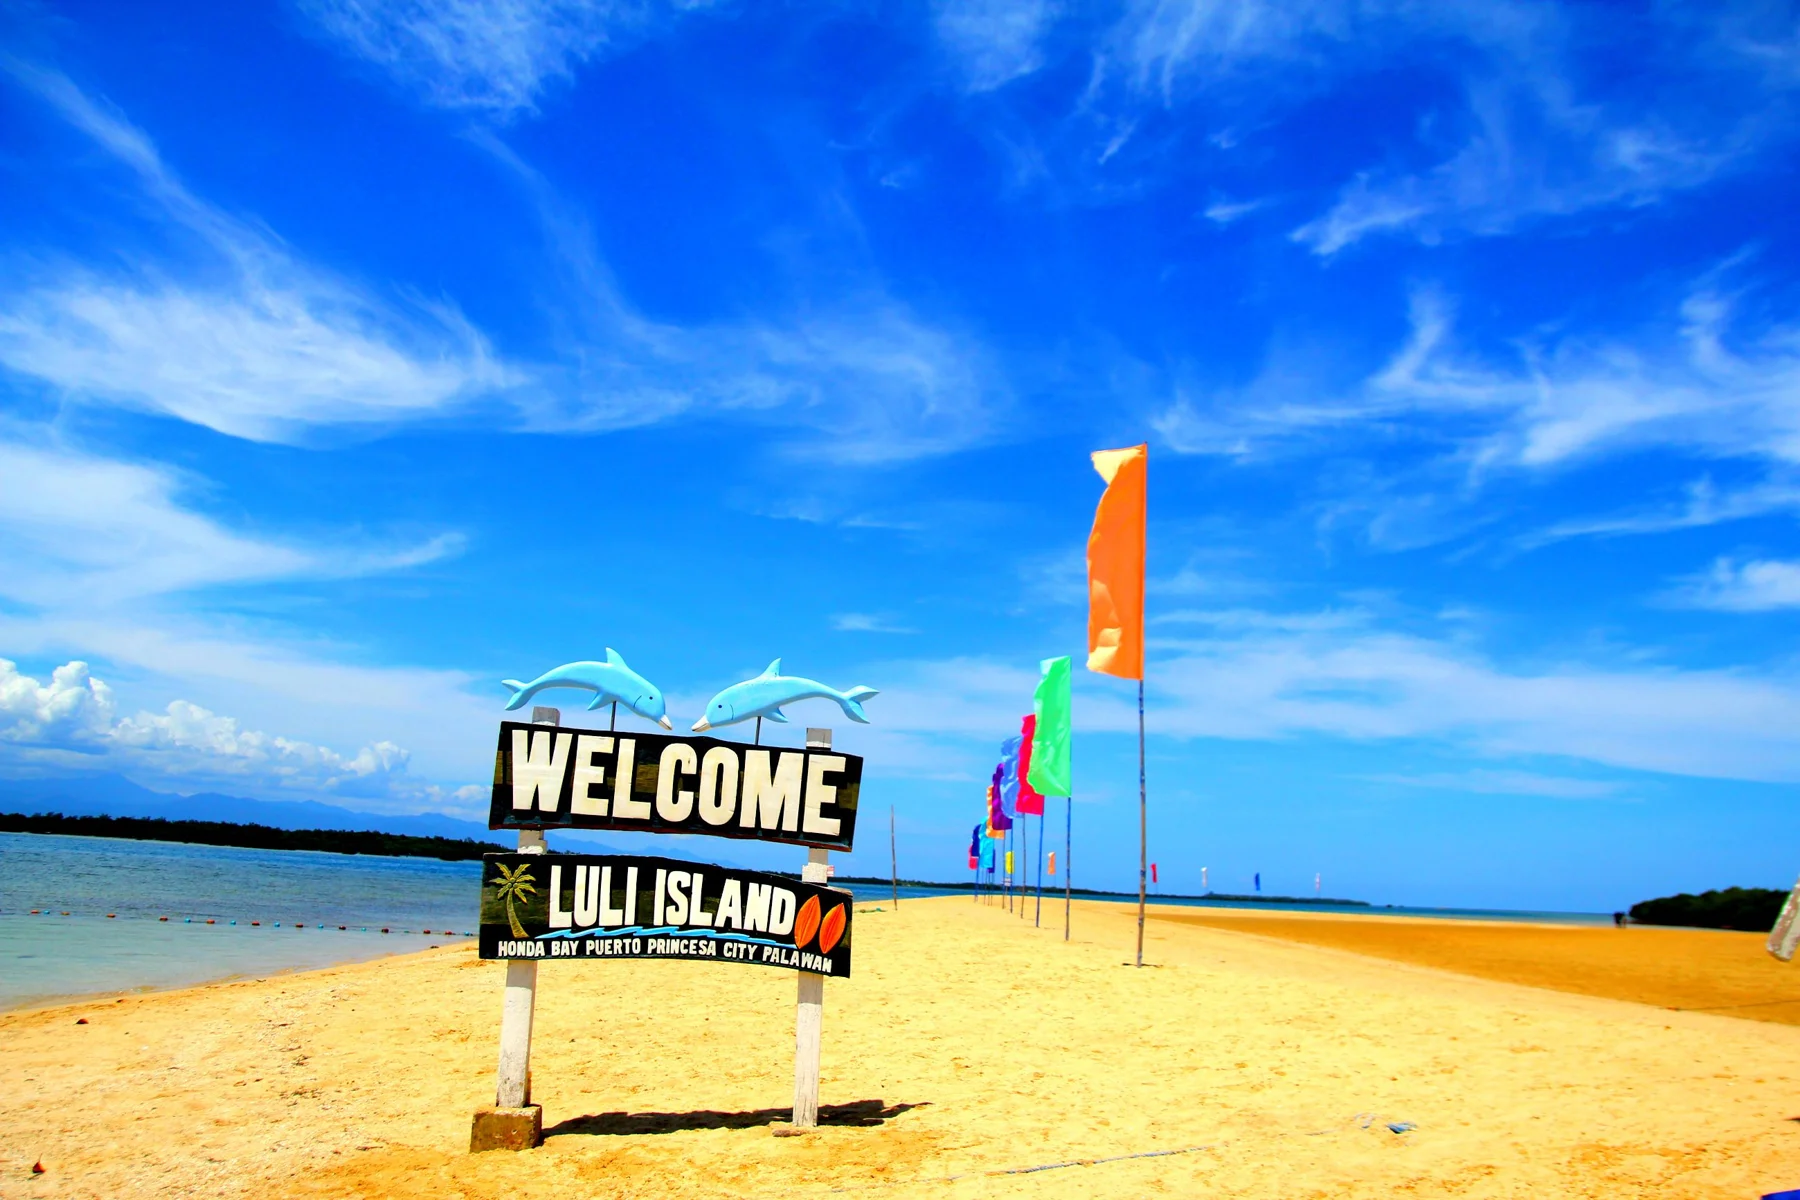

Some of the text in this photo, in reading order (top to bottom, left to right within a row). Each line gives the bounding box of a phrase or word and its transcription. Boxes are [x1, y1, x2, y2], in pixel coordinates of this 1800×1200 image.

[512, 729, 846, 836] WELCOME
[548, 865, 796, 935] LULI ISLAND
[498, 938, 833, 973] HONDA BAY PUERTO PRINCESA CITY PALAWAN
